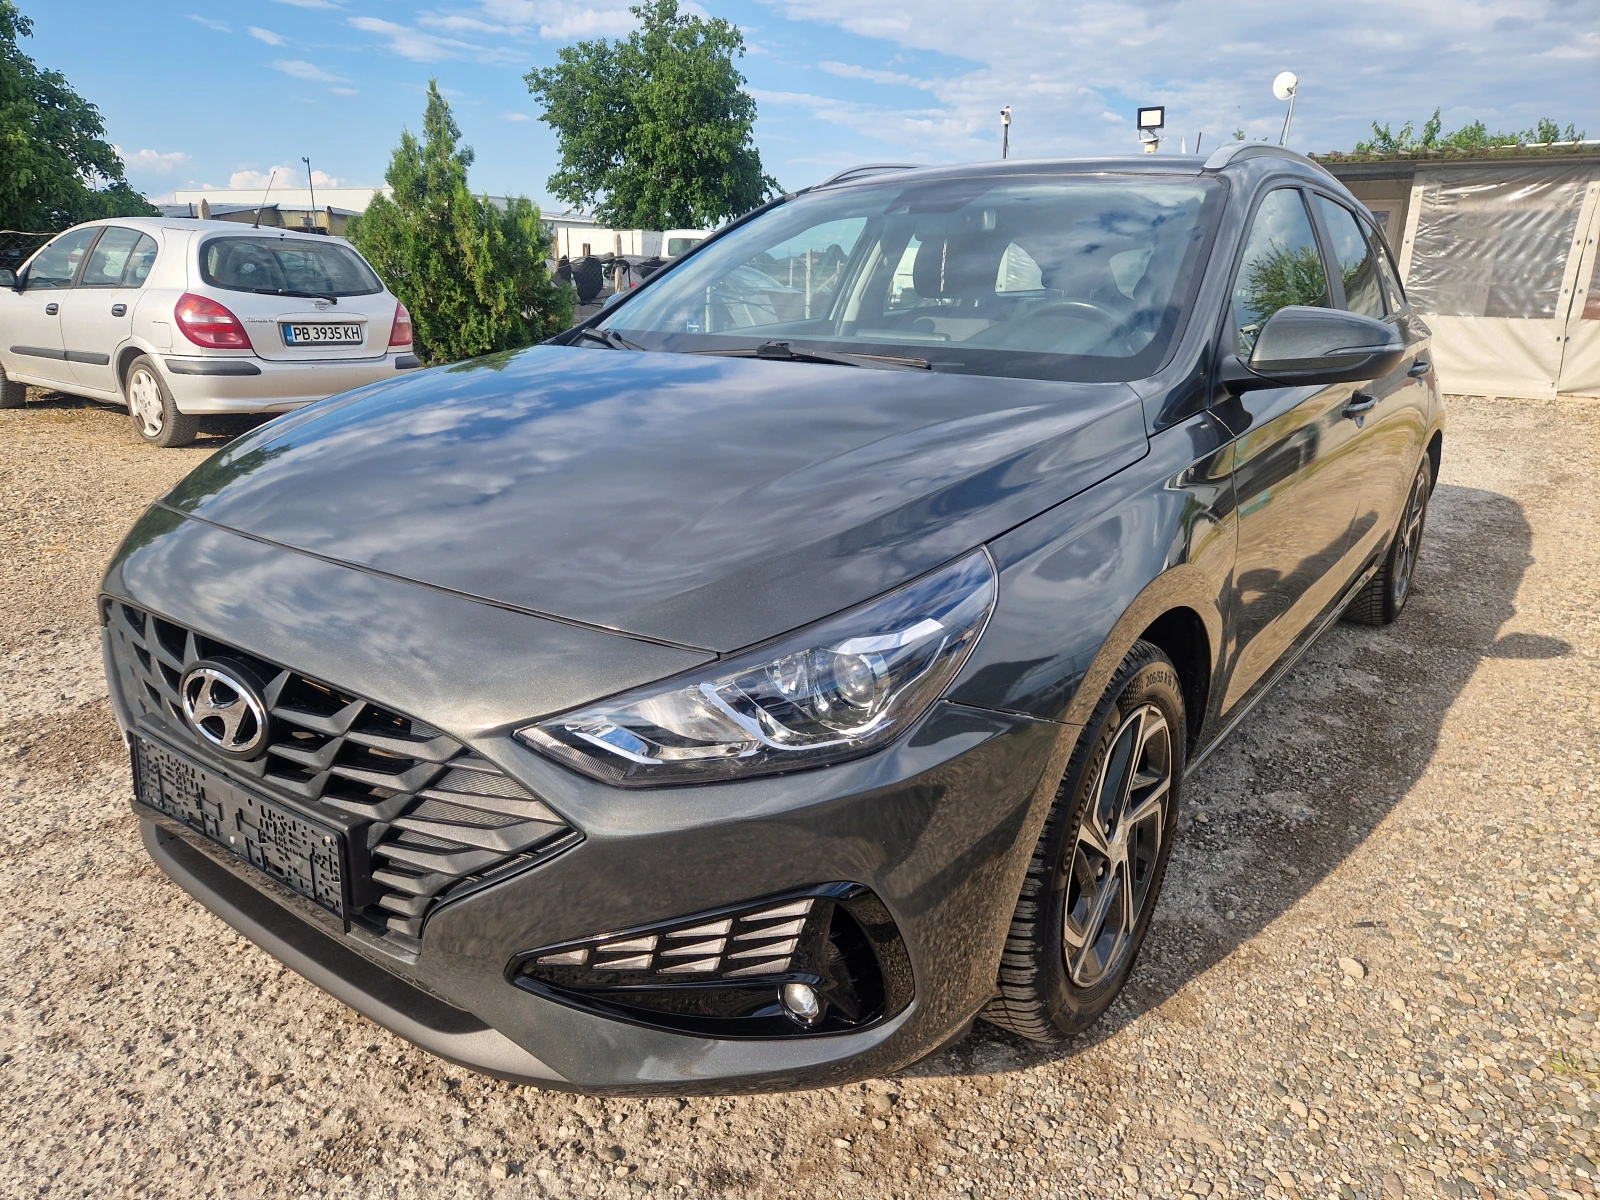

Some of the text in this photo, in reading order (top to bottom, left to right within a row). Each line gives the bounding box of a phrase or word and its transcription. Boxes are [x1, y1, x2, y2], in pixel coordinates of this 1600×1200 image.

[293, 326, 360, 340] PB 3935 KH
[1061, 734, 1108, 876] Continental
